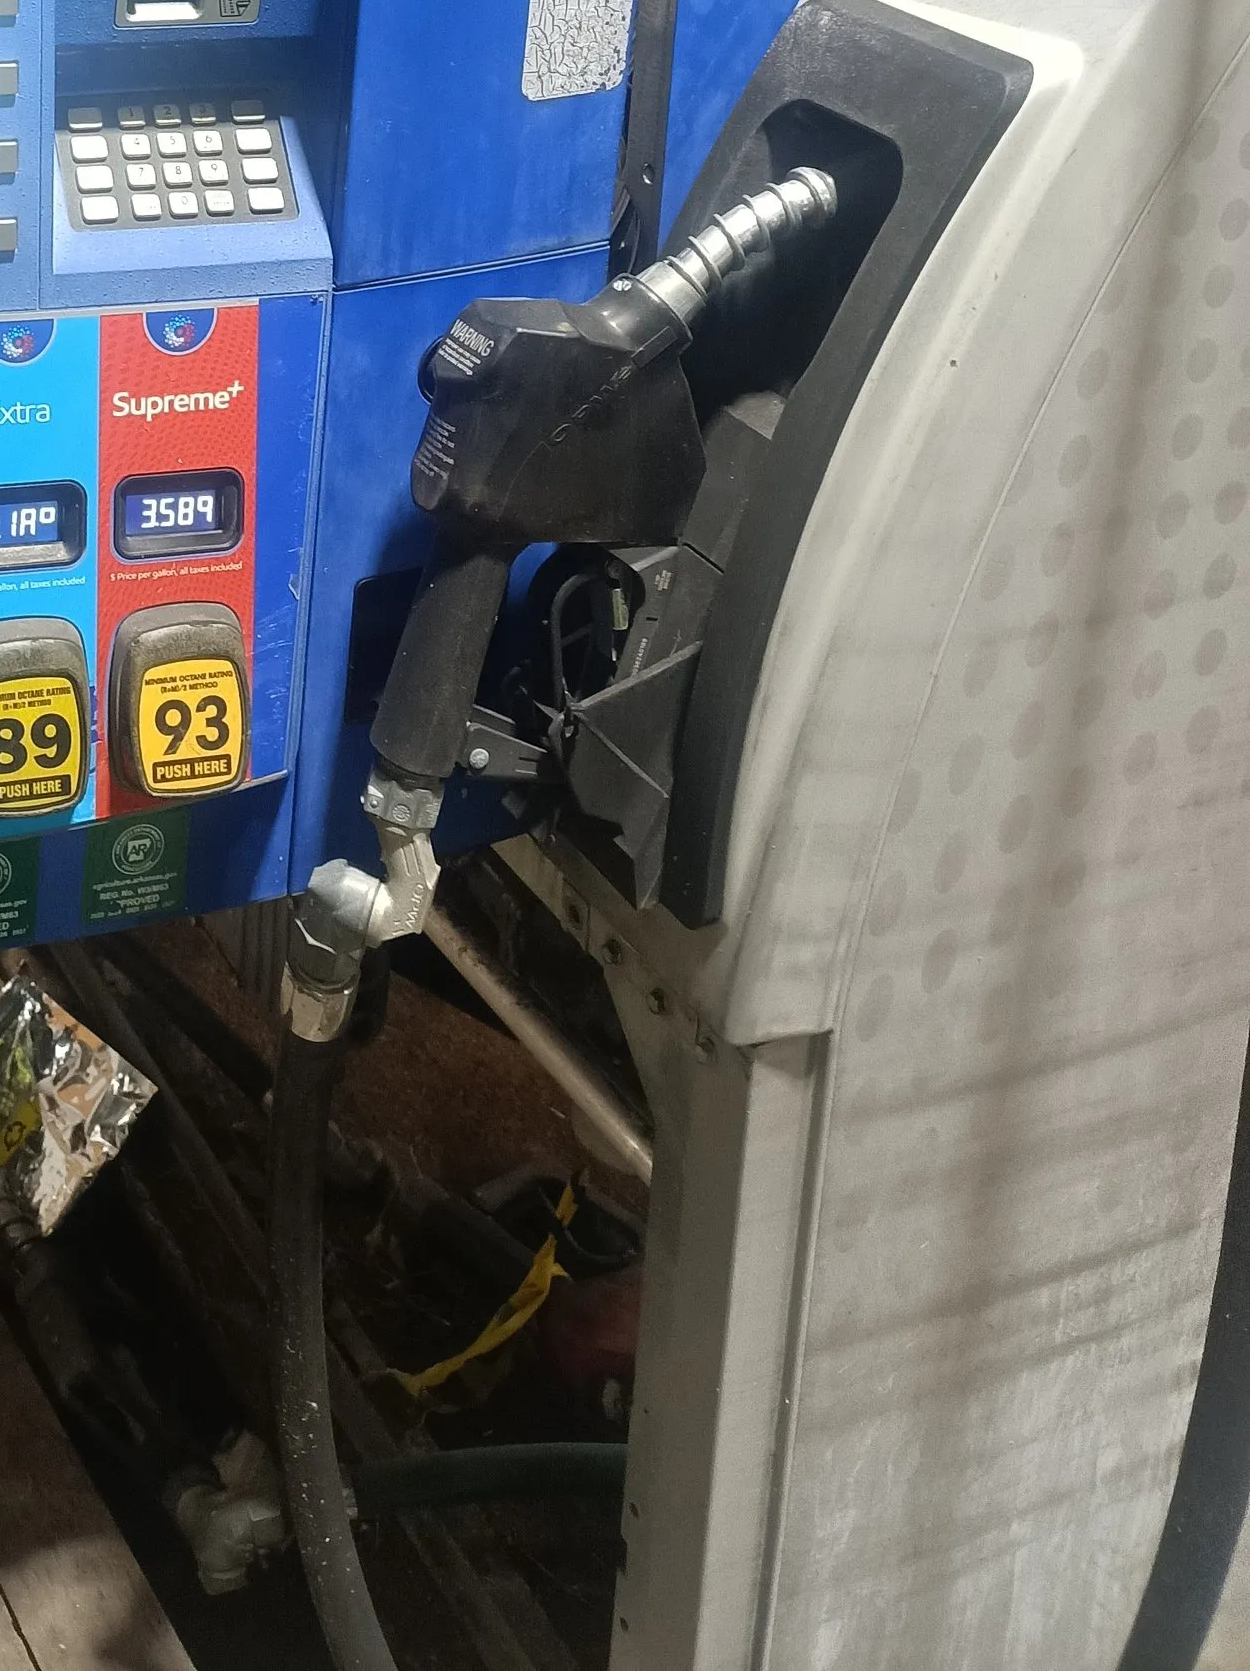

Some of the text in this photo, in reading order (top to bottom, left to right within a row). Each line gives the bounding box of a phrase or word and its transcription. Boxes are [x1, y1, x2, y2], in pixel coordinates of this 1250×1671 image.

[138, 167, 145, 177] 7
[175, 165, 182, 176] 8
[449, 319, 495, 357] WARNING
[112, 379, 244, 422] Supreme+
[110, 561, 243, 581] $ Price per gallon, all taxes included
[20, 580, 30, 590] all
[30, 580, 52, 589] taxes
[52, 576, 87, 587] included
[145, 670, 234, 686] MINIMUM OCTANE RATING
[189, 681, 218, 691] METHOD
[17, 689, 45, 701] OCTANE
[46, 687, 72, 697] RATING
[155, 694, 230, 756] 93
[156, 759, 228, 779] PUSH HERE
[33, 779, 63, 794] HERE
